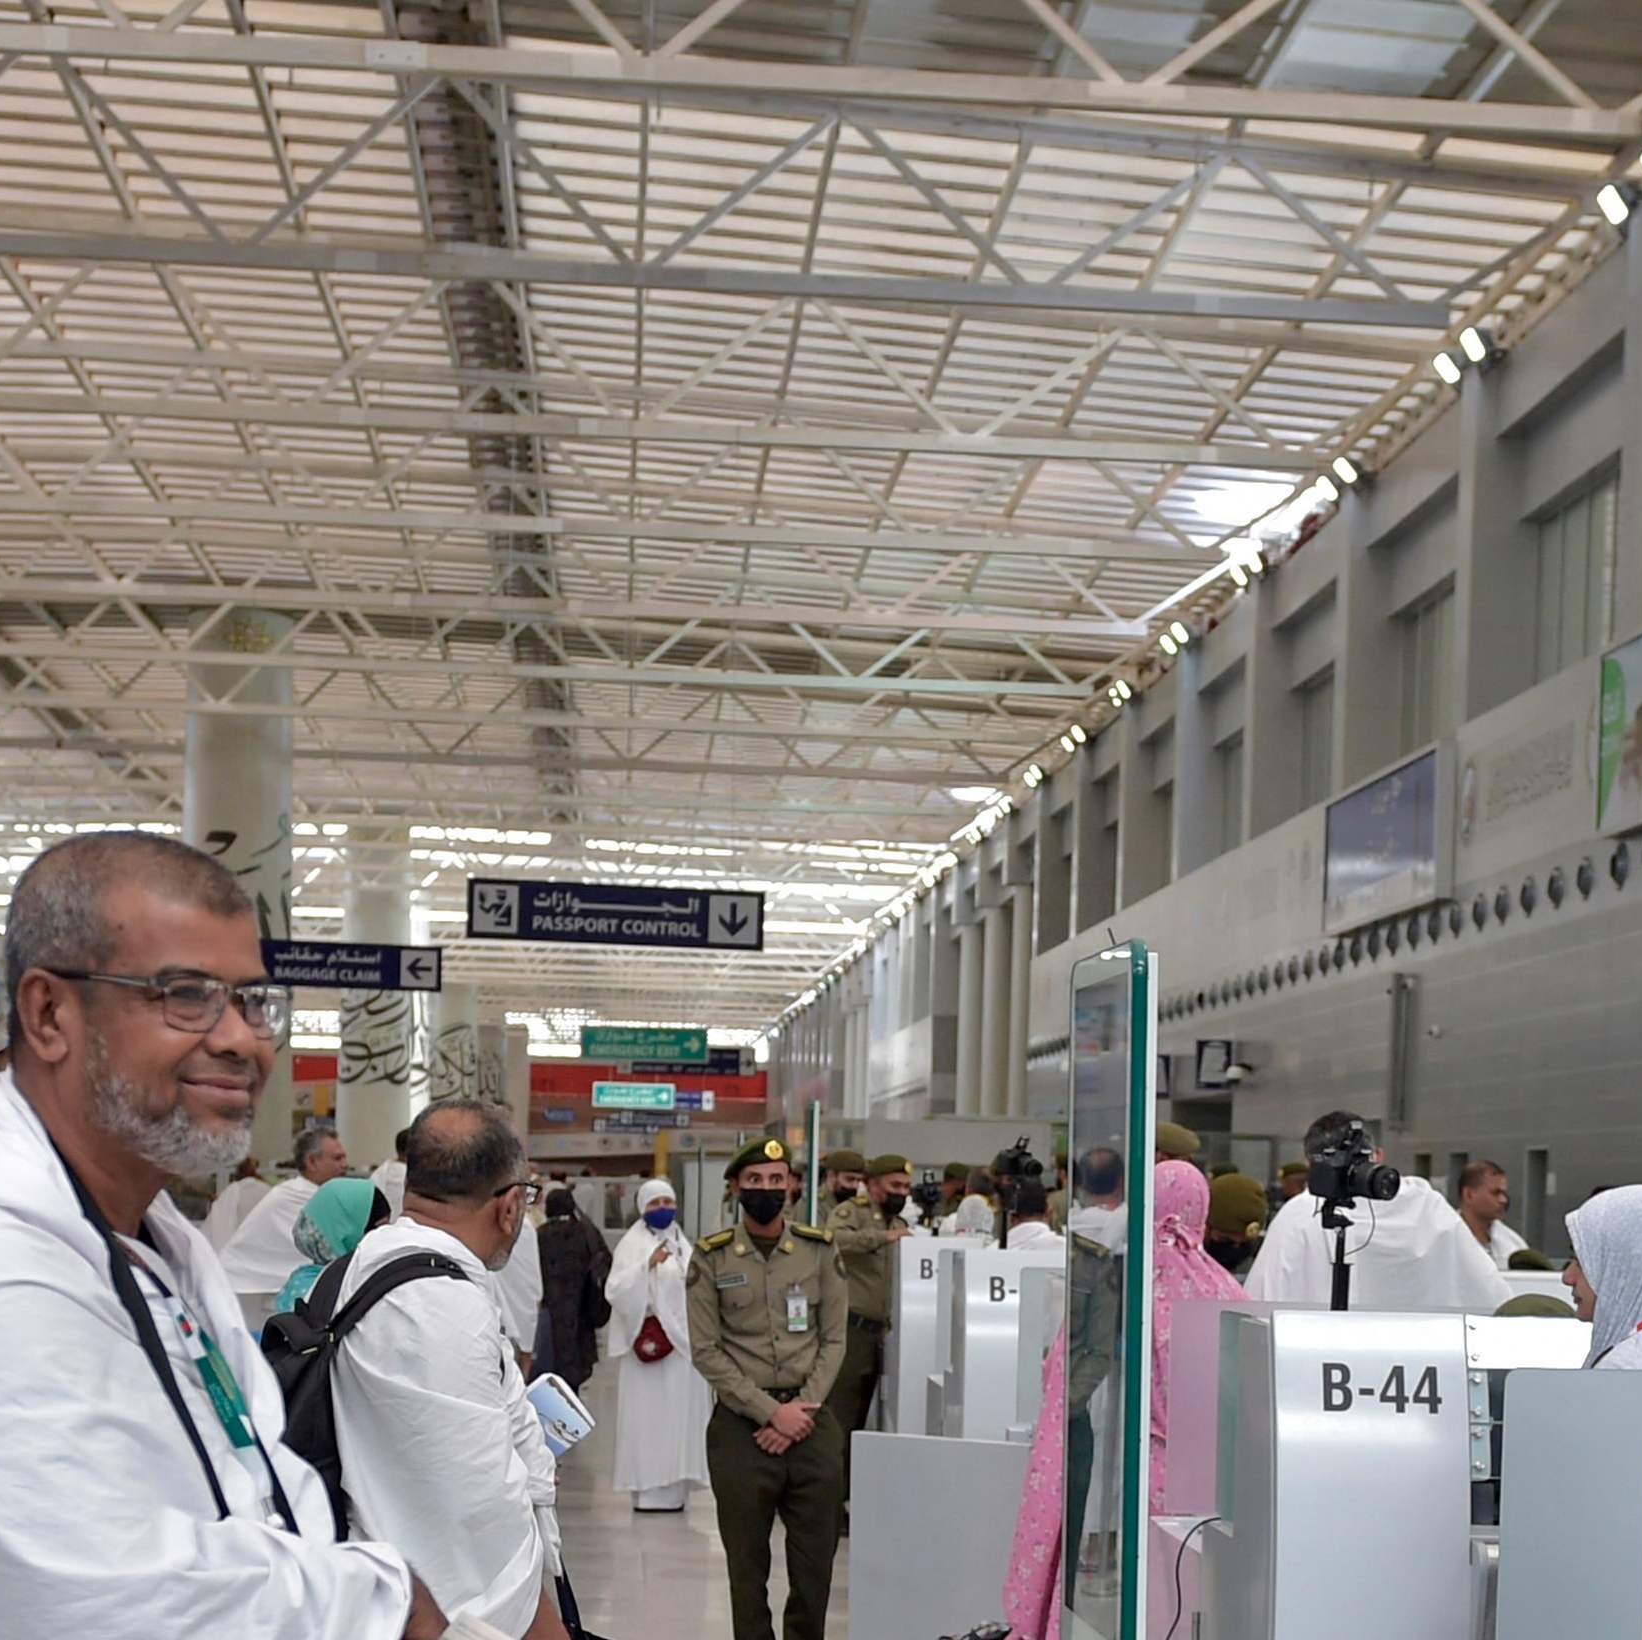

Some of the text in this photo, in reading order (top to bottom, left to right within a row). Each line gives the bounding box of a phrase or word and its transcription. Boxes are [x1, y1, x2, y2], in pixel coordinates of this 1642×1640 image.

[532, 889, 701, 918] الجوازات
[531, 914, 702, 939] PASSPORT CONTROL
[273, 966, 382, 983] BAGGAGE CLAIM
[588, 1043, 681, 1056] EMERGENCY EXIT
[1321, 1362, 1443, 1415] B-44
